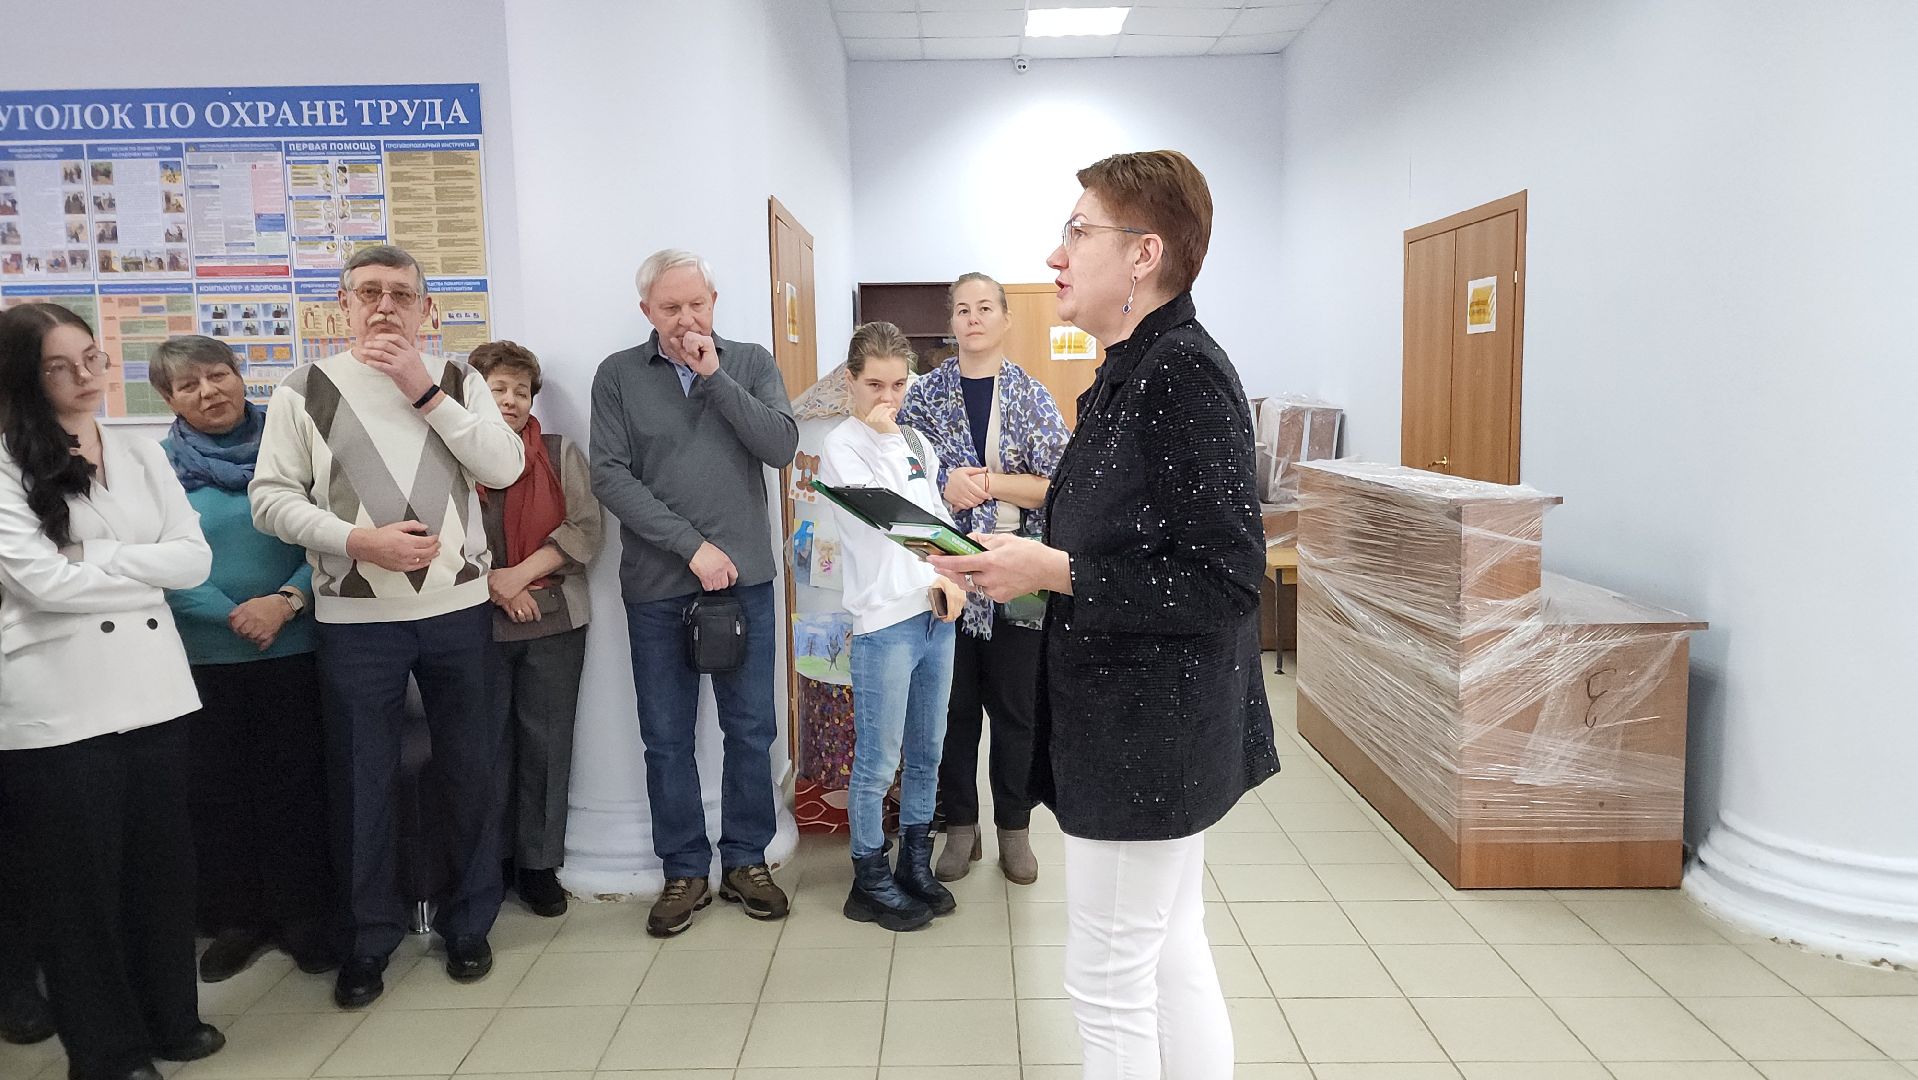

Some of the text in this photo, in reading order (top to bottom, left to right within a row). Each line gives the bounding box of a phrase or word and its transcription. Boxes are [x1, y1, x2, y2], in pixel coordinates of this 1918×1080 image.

[0, 98, 470, 131] УГОЛОК ПО ОХРАНЕ ТРУДА
[288, 142, 377, 151] ПЕРВАЯ ПОМОЩЬ
